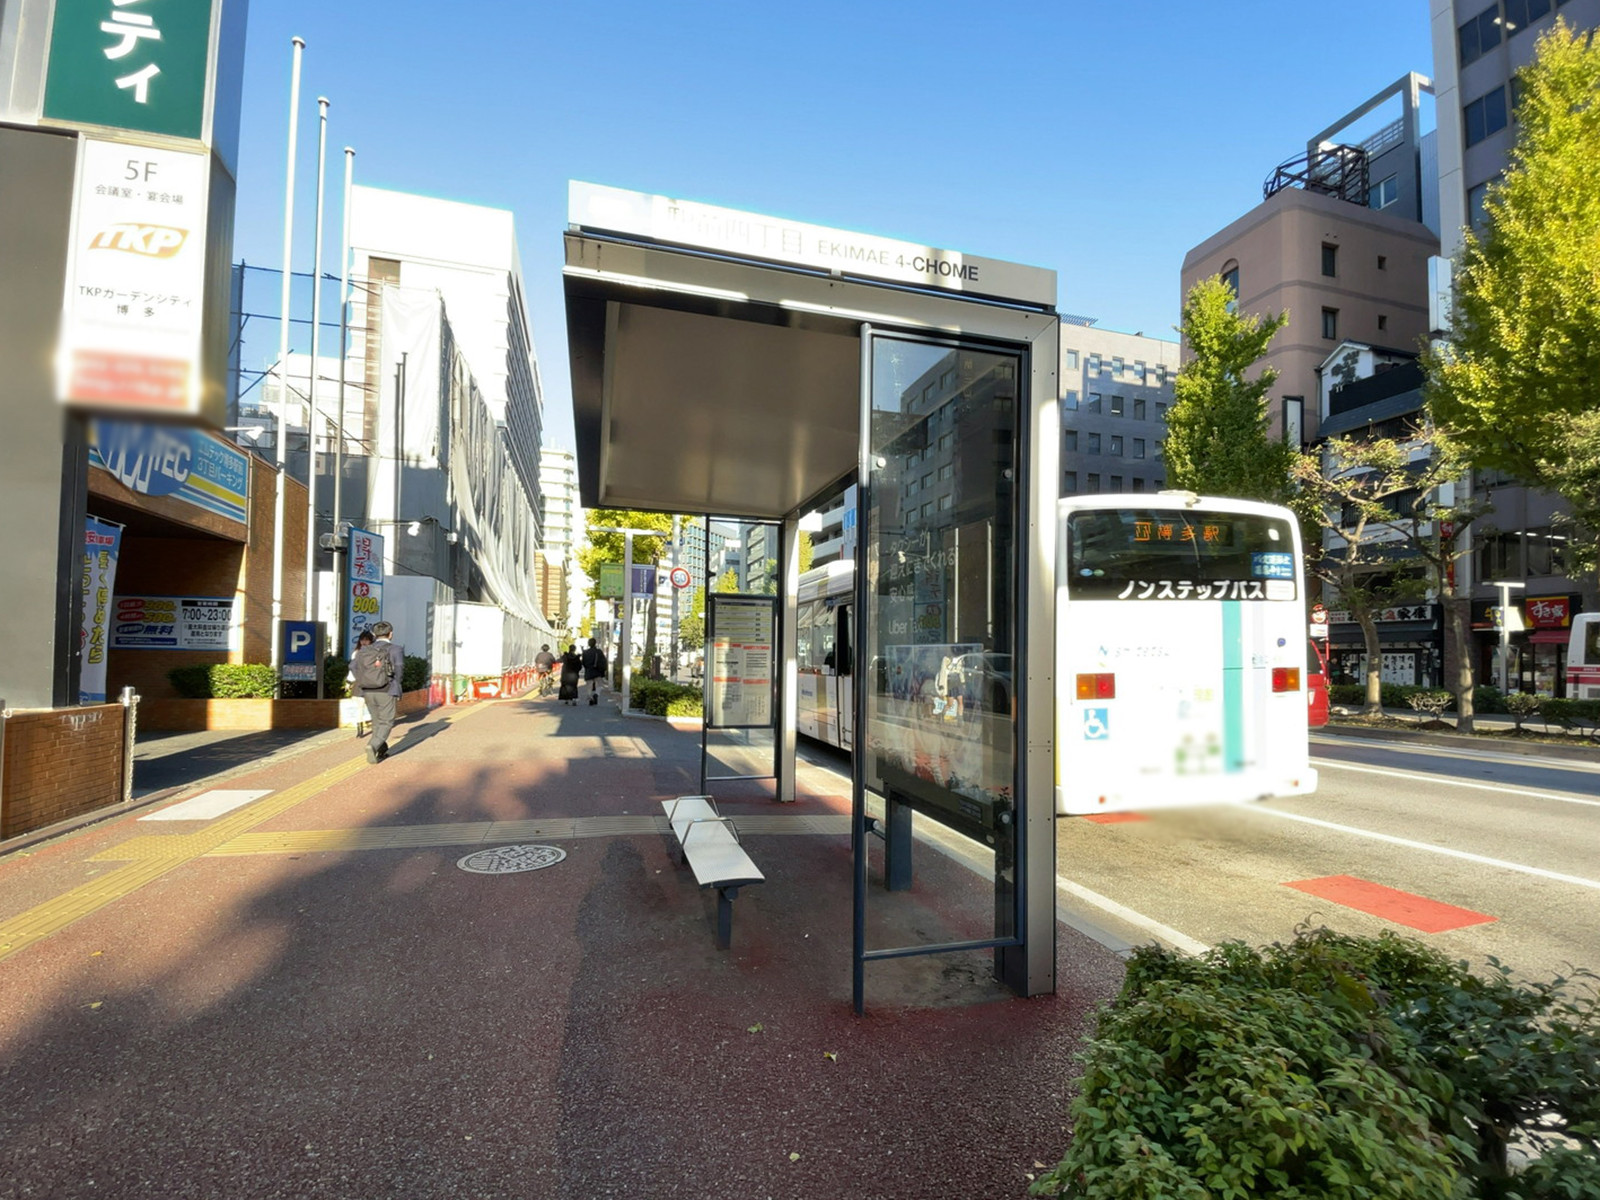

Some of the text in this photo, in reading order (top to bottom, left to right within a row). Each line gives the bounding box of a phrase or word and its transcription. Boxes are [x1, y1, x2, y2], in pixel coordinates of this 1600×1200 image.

[100, 0, 162, 104] ティ
[124, 160, 159, 182] 5F
[95, 184, 185, 205] 会議室・宴会場
[94, 221, 186, 257] TKP
[818, 239, 980, 281] EKIMAE 4-CHOME
[78, 286, 193, 307] TKPガーデンシティ
[1118, 580, 1265, 600] ノンステップバス
[1531, 600, 1564, 618] すき家
[888, 619, 908, 634] Uber
[291, 631, 311, 653] P
